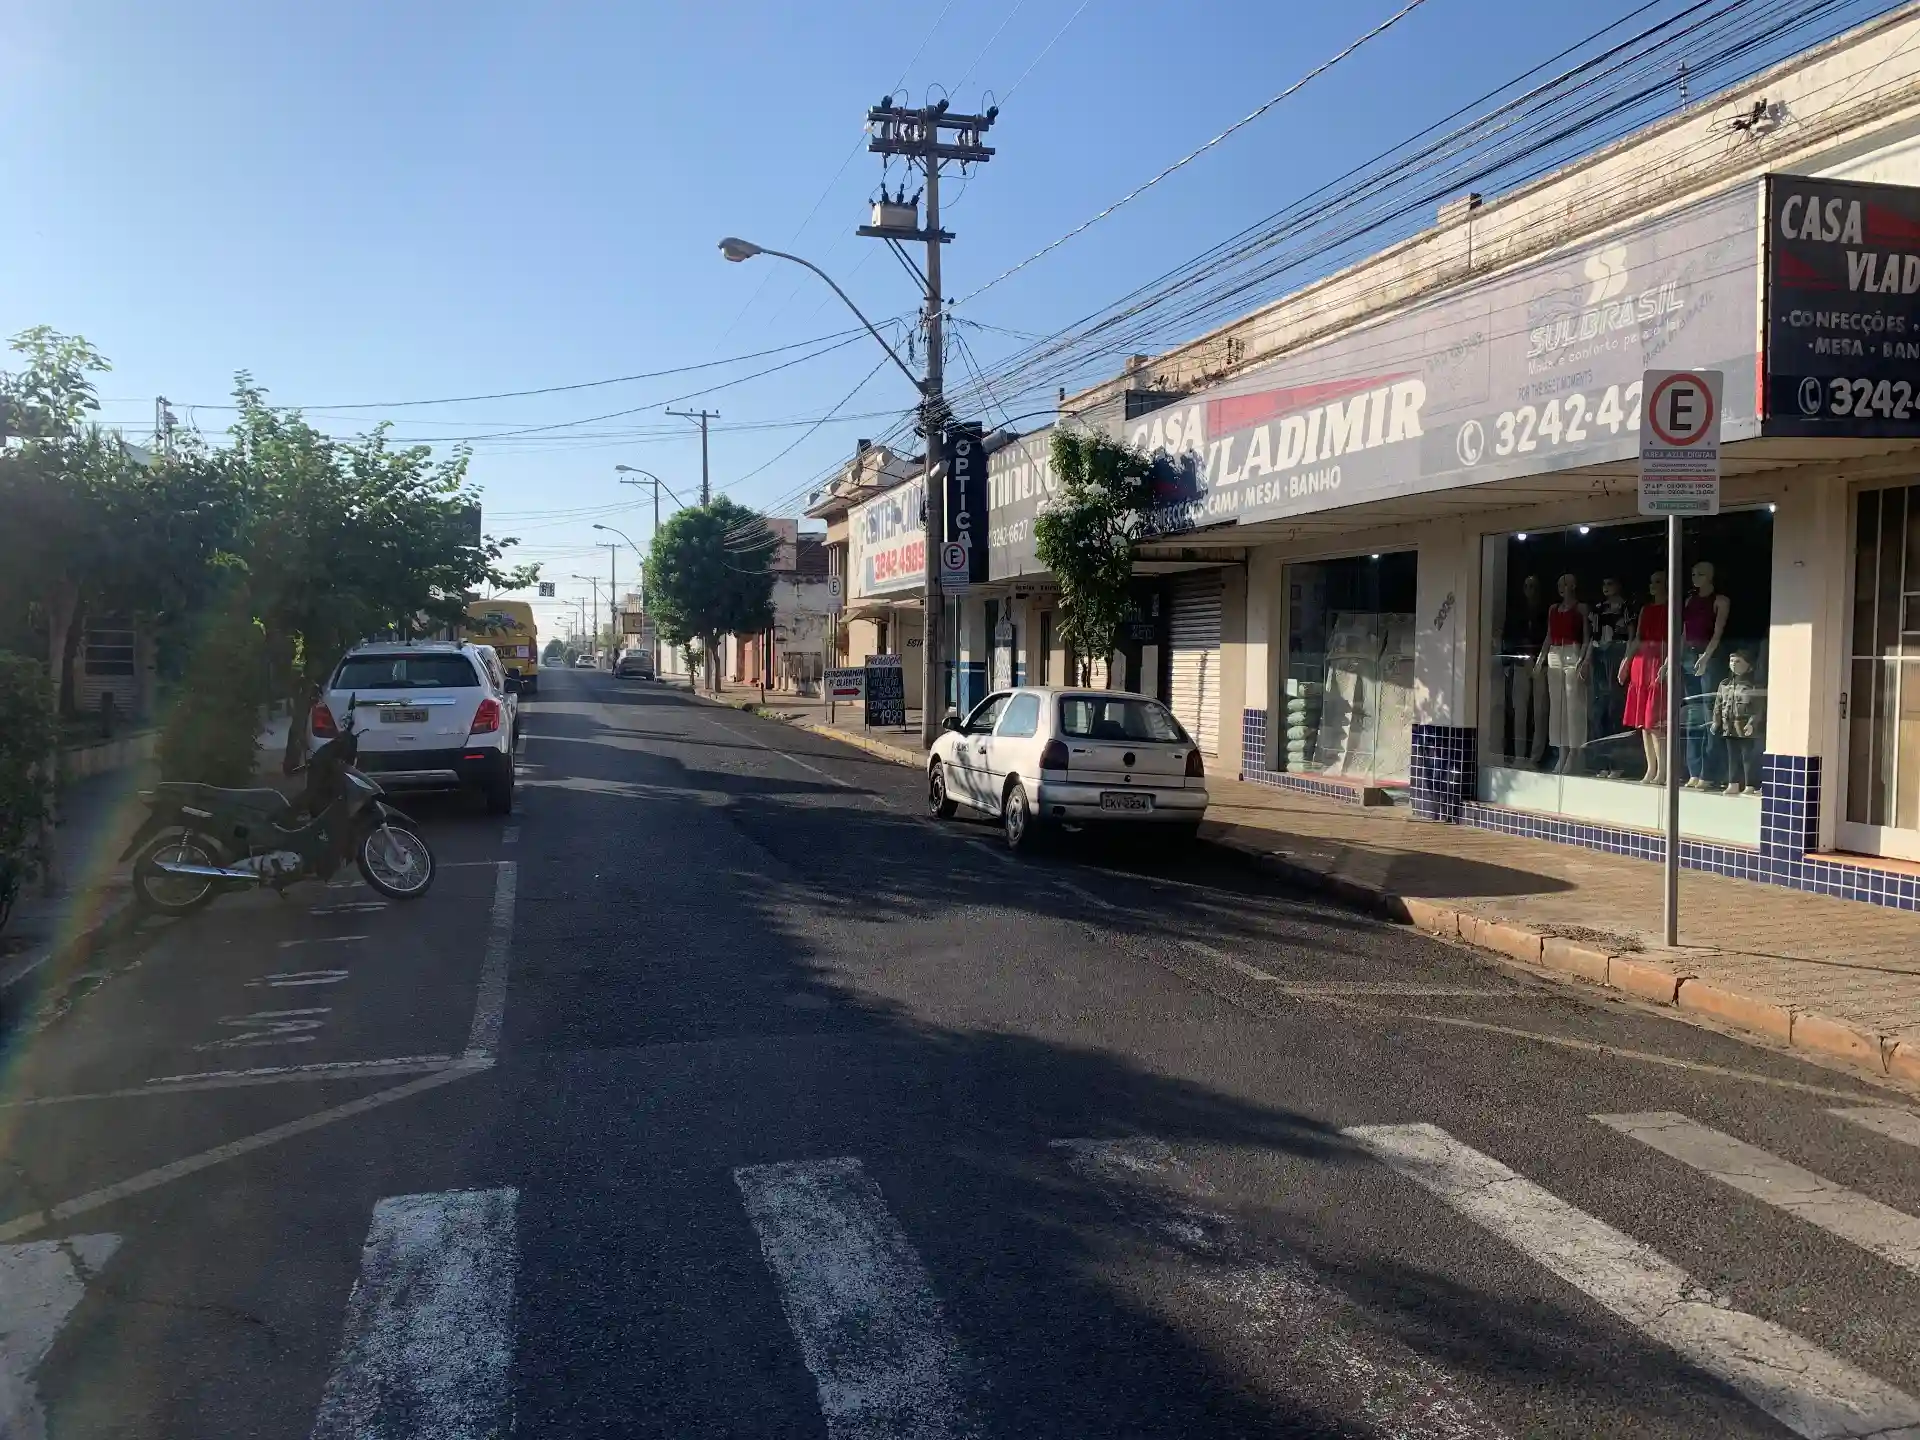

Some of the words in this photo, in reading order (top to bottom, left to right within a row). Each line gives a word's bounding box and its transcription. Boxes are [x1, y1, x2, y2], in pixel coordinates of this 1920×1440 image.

[1780, 195, 1863, 245] CASA
[1815, 337, 1863, 357] MESA
[1669, 389, 1694, 431] E
[1828, 377, 1920, 419] 3242-
[1131, 404, 1204, 456] CASA
[1195, 379, 1427, 492] VLADIMIR
[1687, 451, 1715, 459] DIGITAL
[1208, 491, 1239, 516] CAMA
[1245, 484, 1280, 509] MESA
[1289, 465, 1342, 498] BANHO
[950, 548, 961, 564] E
[832, 581, 838, 592] E
[836, 677, 863, 688] CLIENTES
